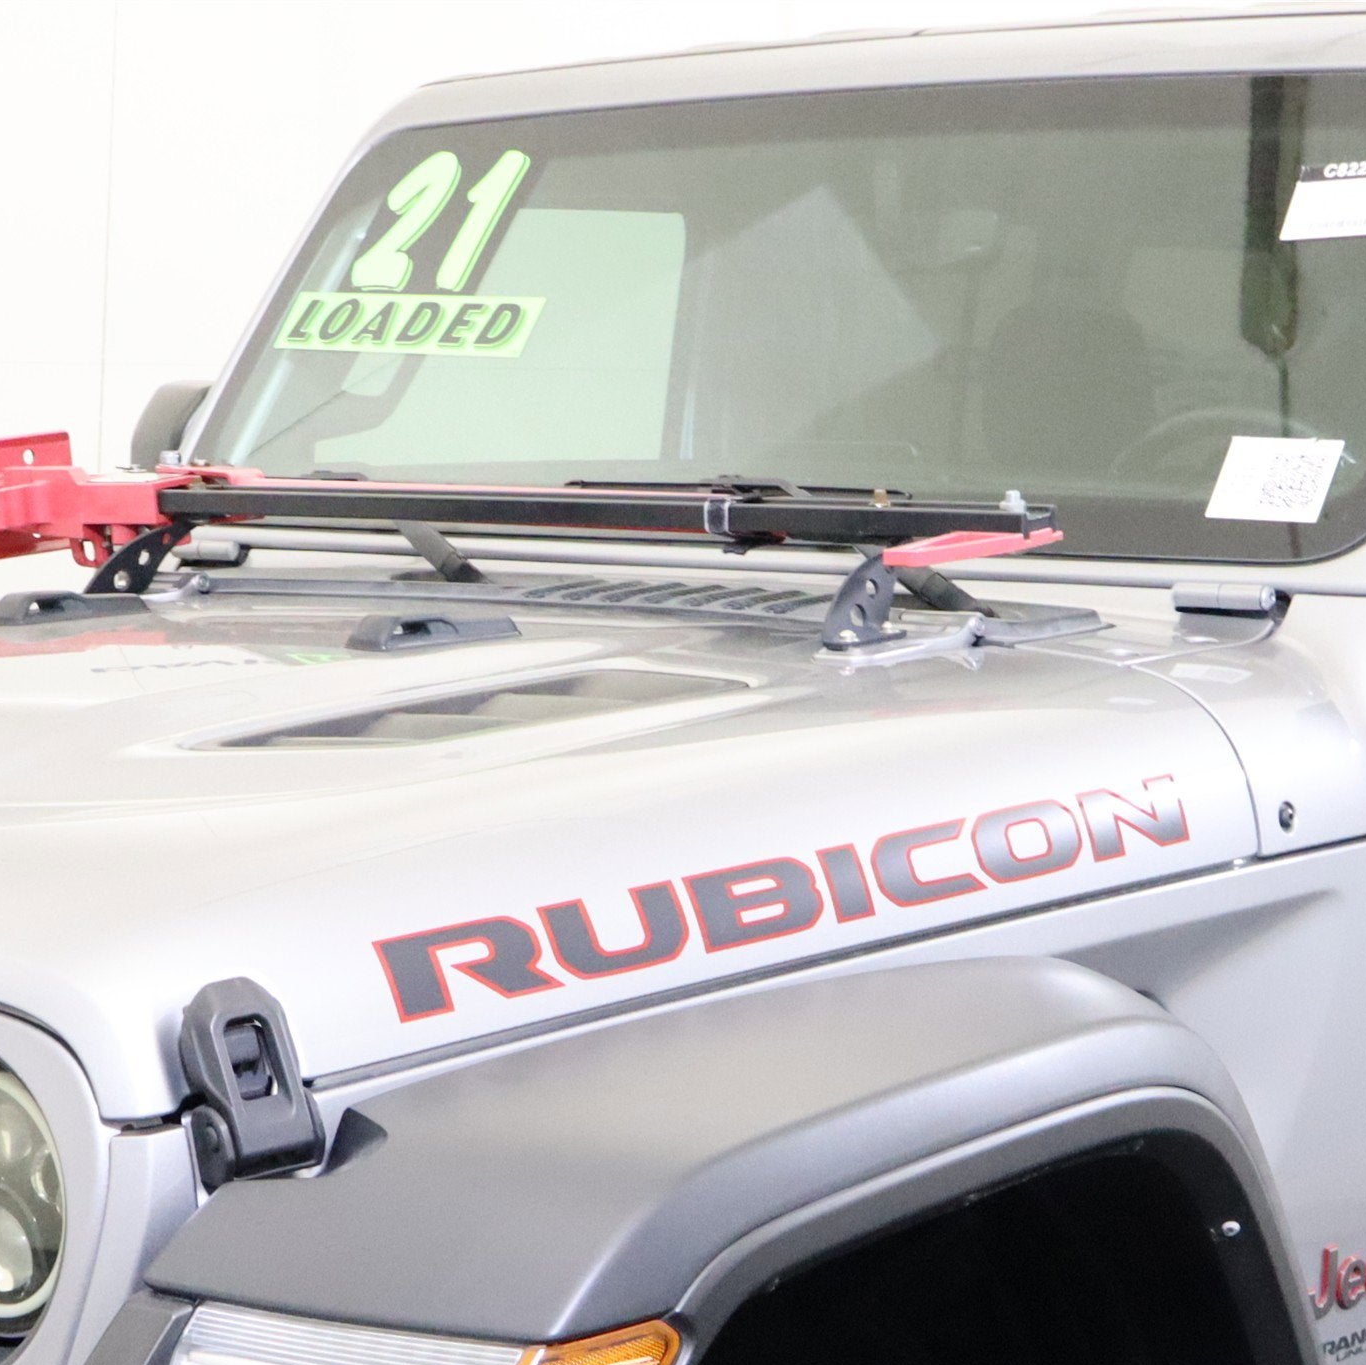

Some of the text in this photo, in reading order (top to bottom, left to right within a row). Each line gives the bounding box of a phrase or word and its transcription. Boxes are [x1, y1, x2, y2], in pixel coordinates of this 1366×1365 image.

[351, 149, 531, 292] 21
[286, 298, 526, 348] LOADED
[371, 775, 1191, 1024] RUBICON
